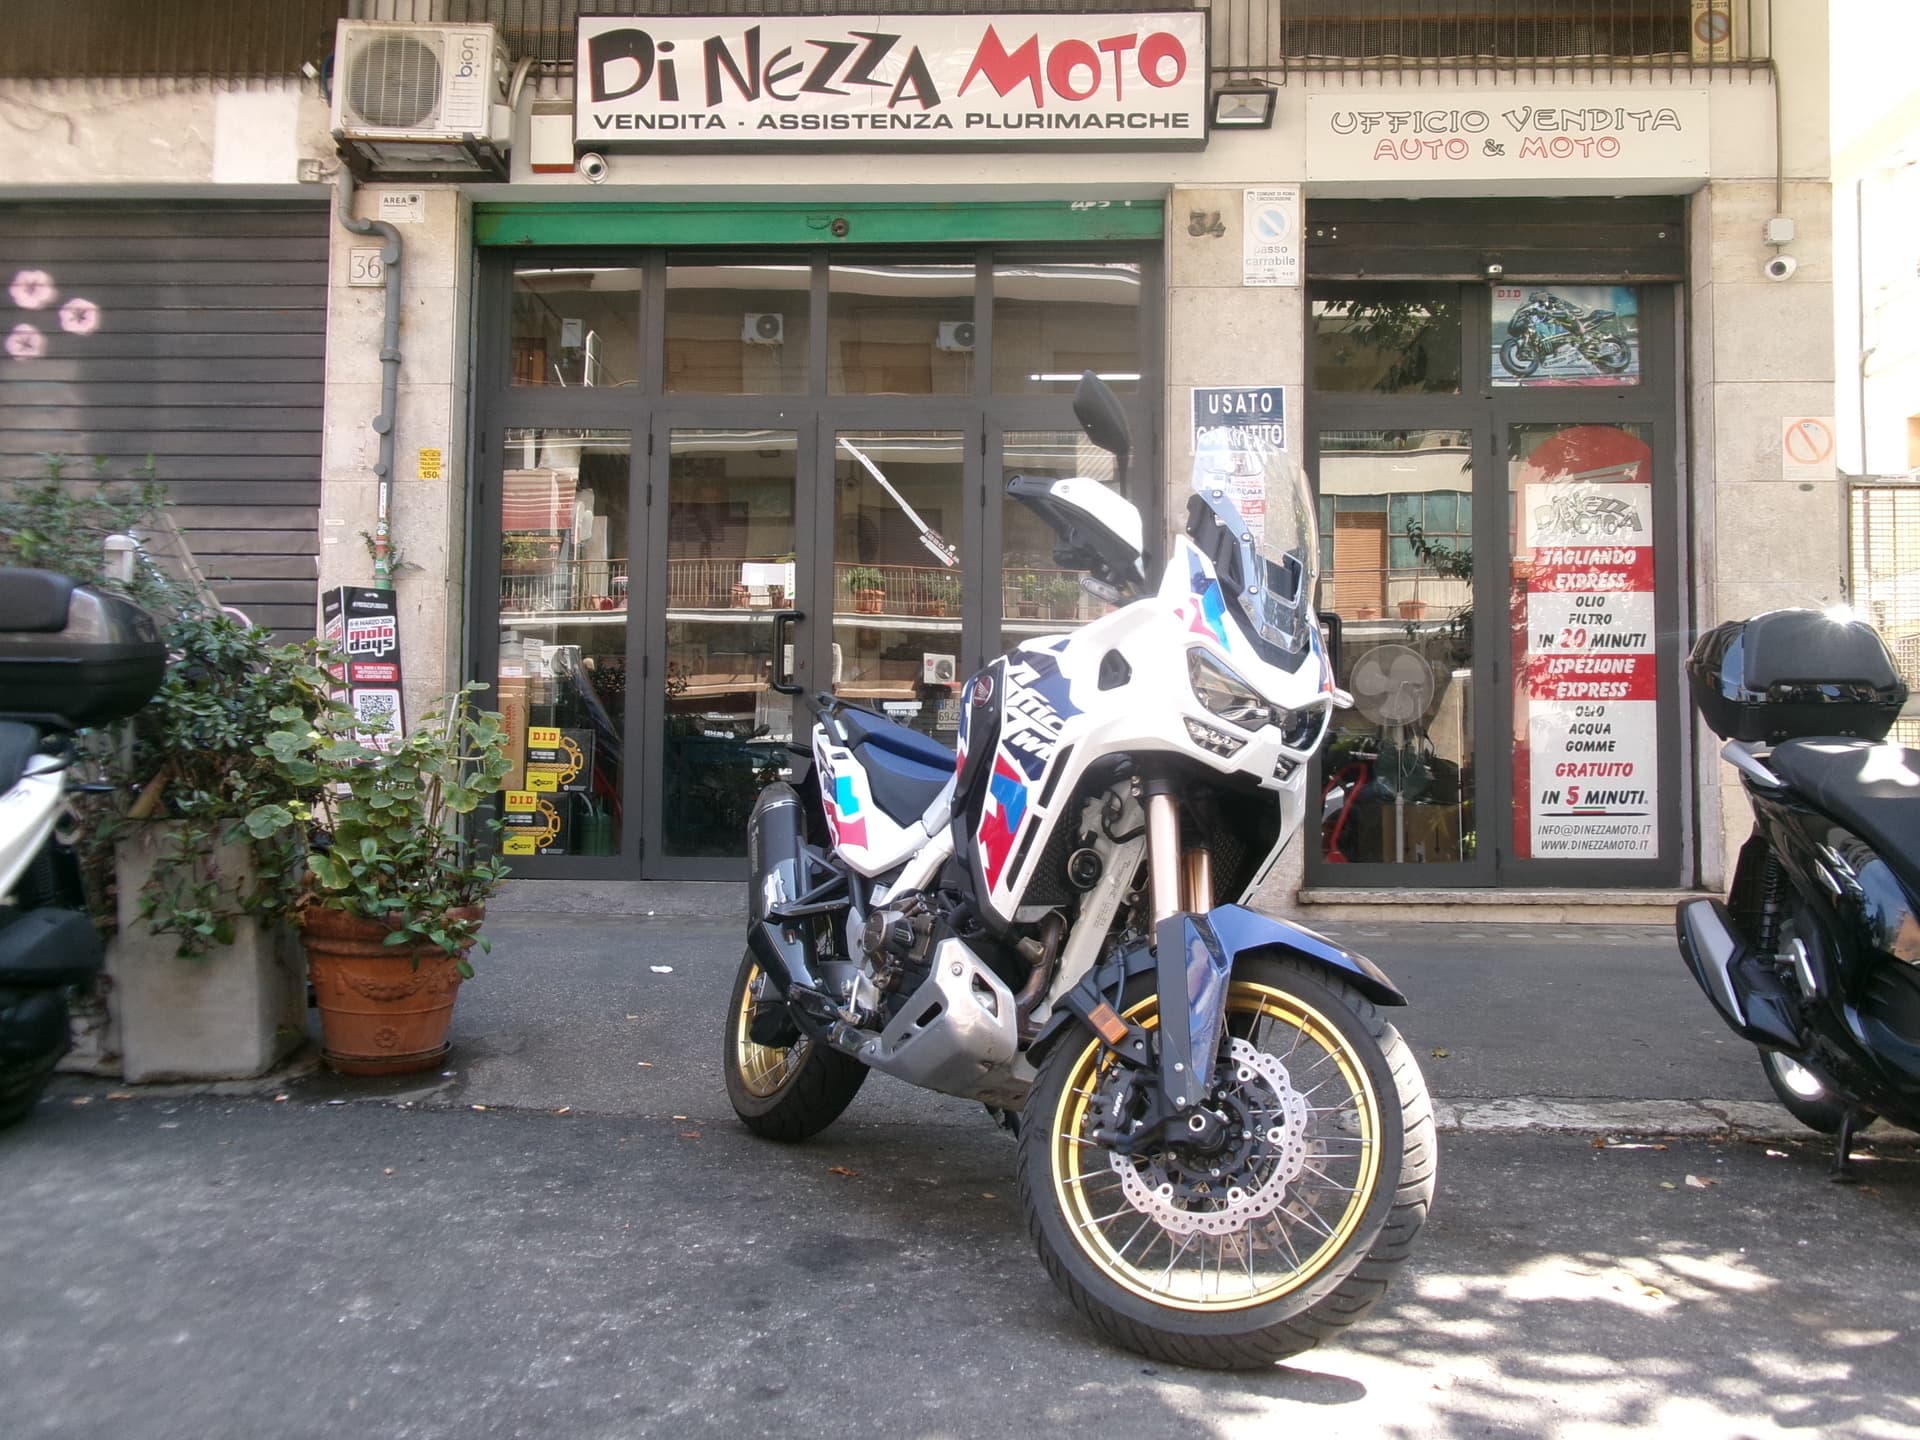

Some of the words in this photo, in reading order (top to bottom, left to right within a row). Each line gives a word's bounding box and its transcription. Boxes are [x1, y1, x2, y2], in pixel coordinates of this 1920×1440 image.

[957, 23, 1187, 109] MOTO
[593, 114, 727, 129] VENDITA
[756, 113, 953, 129] ASSISTENZA
[965, 112, 1189, 129] PLURIMARCHE
[1331, 110, 1490, 135] UFFICIO
[1502, 106, 1682, 132] VENDITA
[1374, 138, 1469, 161] AUTO
[1482, 139, 1505, 157] &
[1519, 136, 1620, 158] MOTO
[1255, 246, 1288, 256] passo
[352, 255, 381, 279] 36
[1246, 256, 1296, 266] carrabile
[1497, 289, 1521, 298] DID
[1209, 393, 1273, 414] USATO
[1196, 424, 1283, 446] GANTITO
[1541, 550, 1636, 565] TAGLIANDO
[1556, 573, 1627, 588] EXPRESS
[1576, 596, 1605, 607] OLIO
[1569, 613, 1612, 625] FILTRO
[350, 626, 393, 640] moto
[1537, 633, 1554, 648] IN
[1560, 628, 1587, 648] 20
[1591, 633, 1646, 648] MINUTI
[350, 639, 393, 654] days
[1549, 658, 1636, 674] ISPEZIONE
[1556, 681, 1629, 698] EXPRESS
[1575, 705, 1605, 717] OLIO
[533, 732, 556, 741] DID
[1569, 723, 1611, 735] ACQUA
[1566, 740, 1616, 752] GOMME
[1555, 763, 1634, 778] GRATUITO
[510, 795, 533, 805] DID
[1541, 790, 1560, 805] IN
[1566, 786, 1580, 806] 5
[1538, 825, 1652, 836] INFO@DINEZZAMOTO.IT
[1541, 840, 1649, 851] WWW.DINEZZAMOTO.IT
